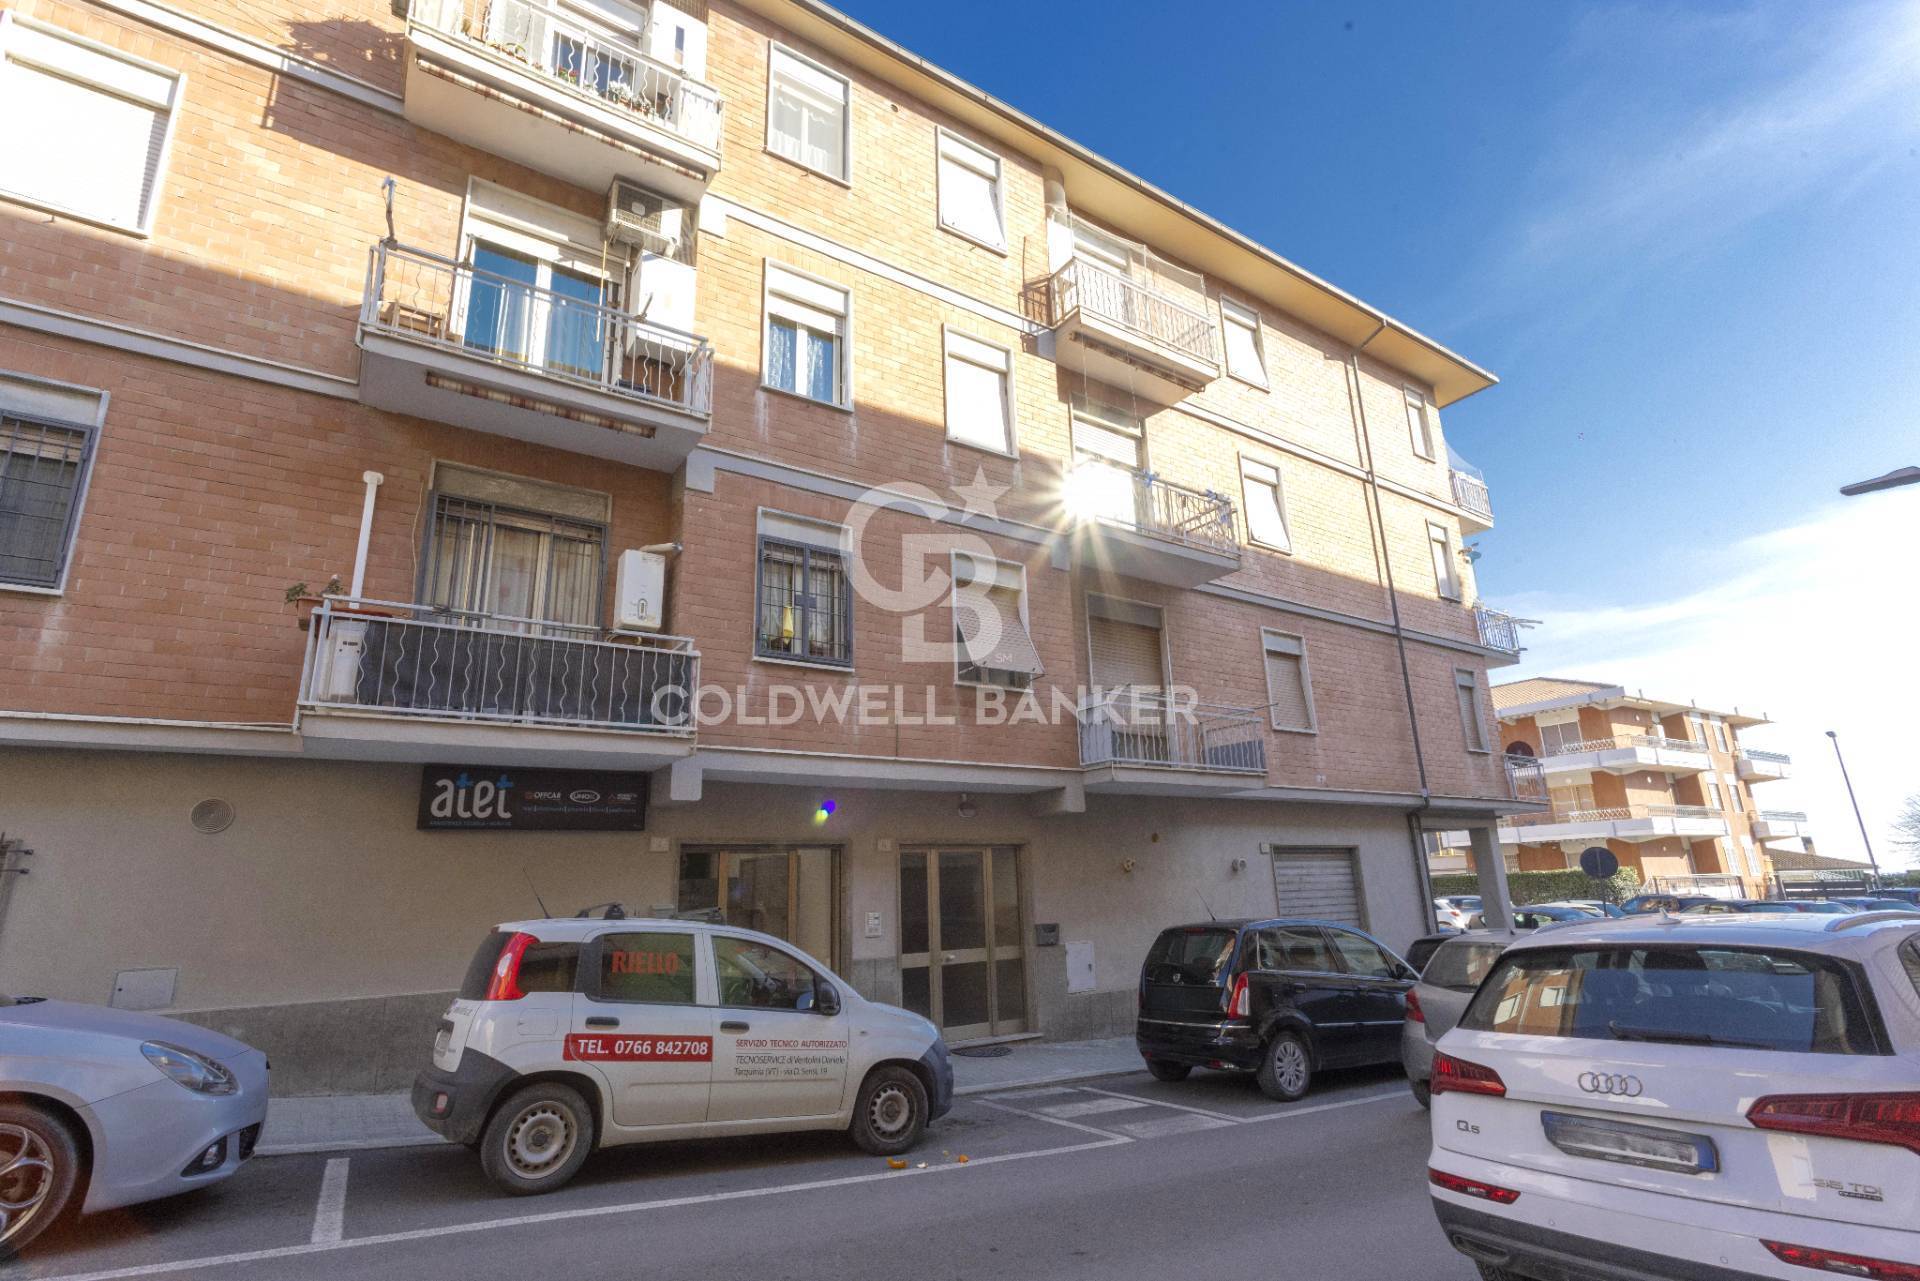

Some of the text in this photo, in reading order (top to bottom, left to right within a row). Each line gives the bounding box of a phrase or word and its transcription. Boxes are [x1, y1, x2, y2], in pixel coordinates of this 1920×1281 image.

[611, 950, 679, 976] RIELLO
[578, 1039, 709, 1056] TEL. 0766 842708
[736, 1039, 848, 1049] SERVIZIO TECNICO AUTORIZZATO
[736, 1055, 786, 1065] TECNOSERVICE
[1456, 1119, 1480, 1134] Q5
